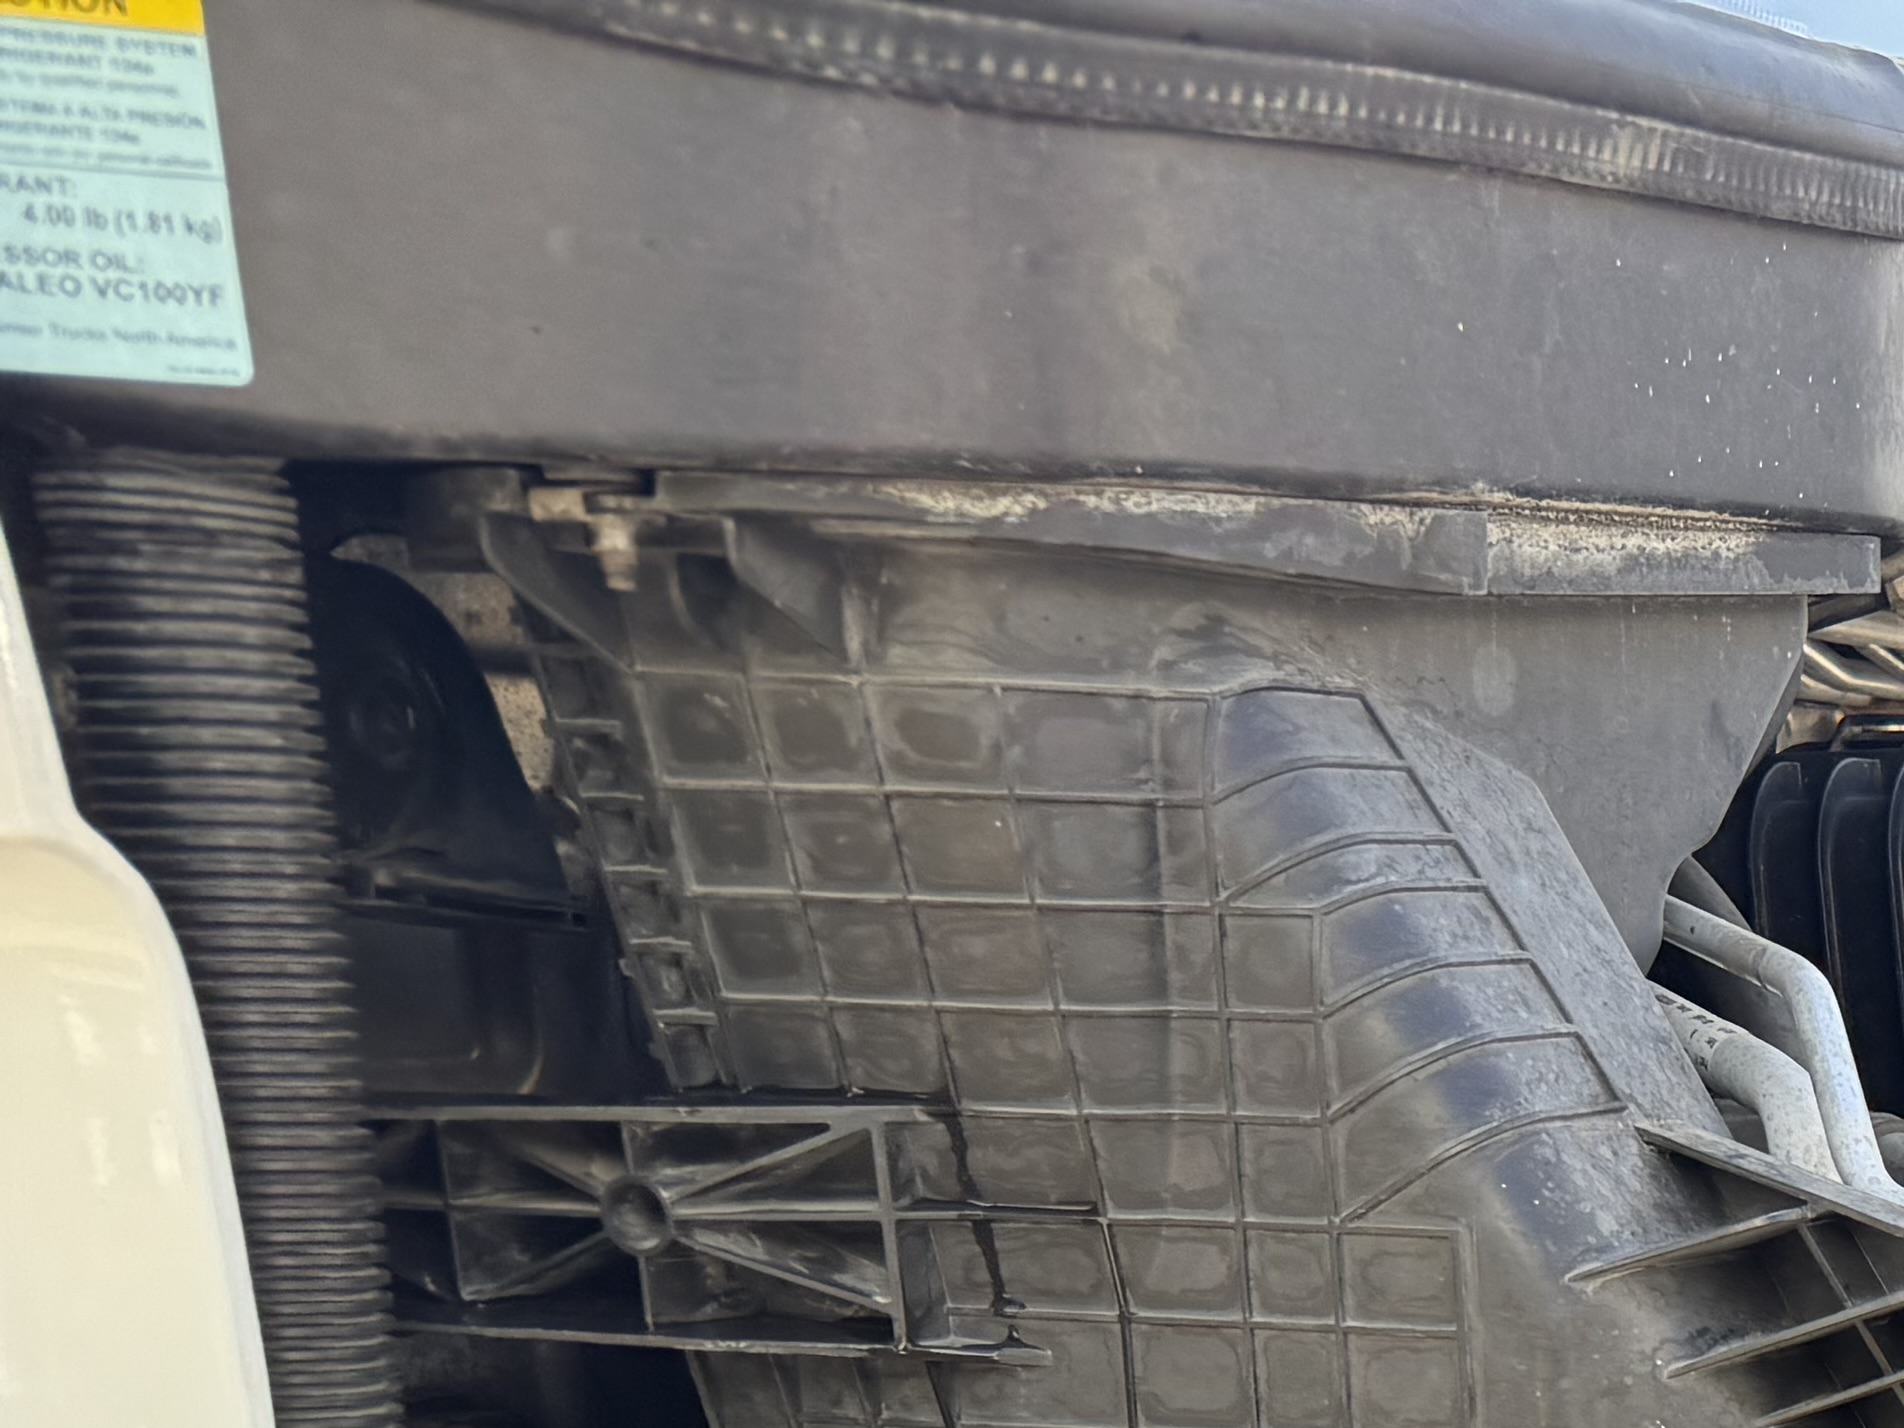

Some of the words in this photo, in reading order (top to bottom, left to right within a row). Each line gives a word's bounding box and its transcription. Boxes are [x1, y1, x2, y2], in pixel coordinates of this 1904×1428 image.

[23, 203, 76, 228] 4.00
[84, 207, 108, 232] lb
[113, 209, 174, 239] (1.81
[184, 212, 223, 245] kg)
